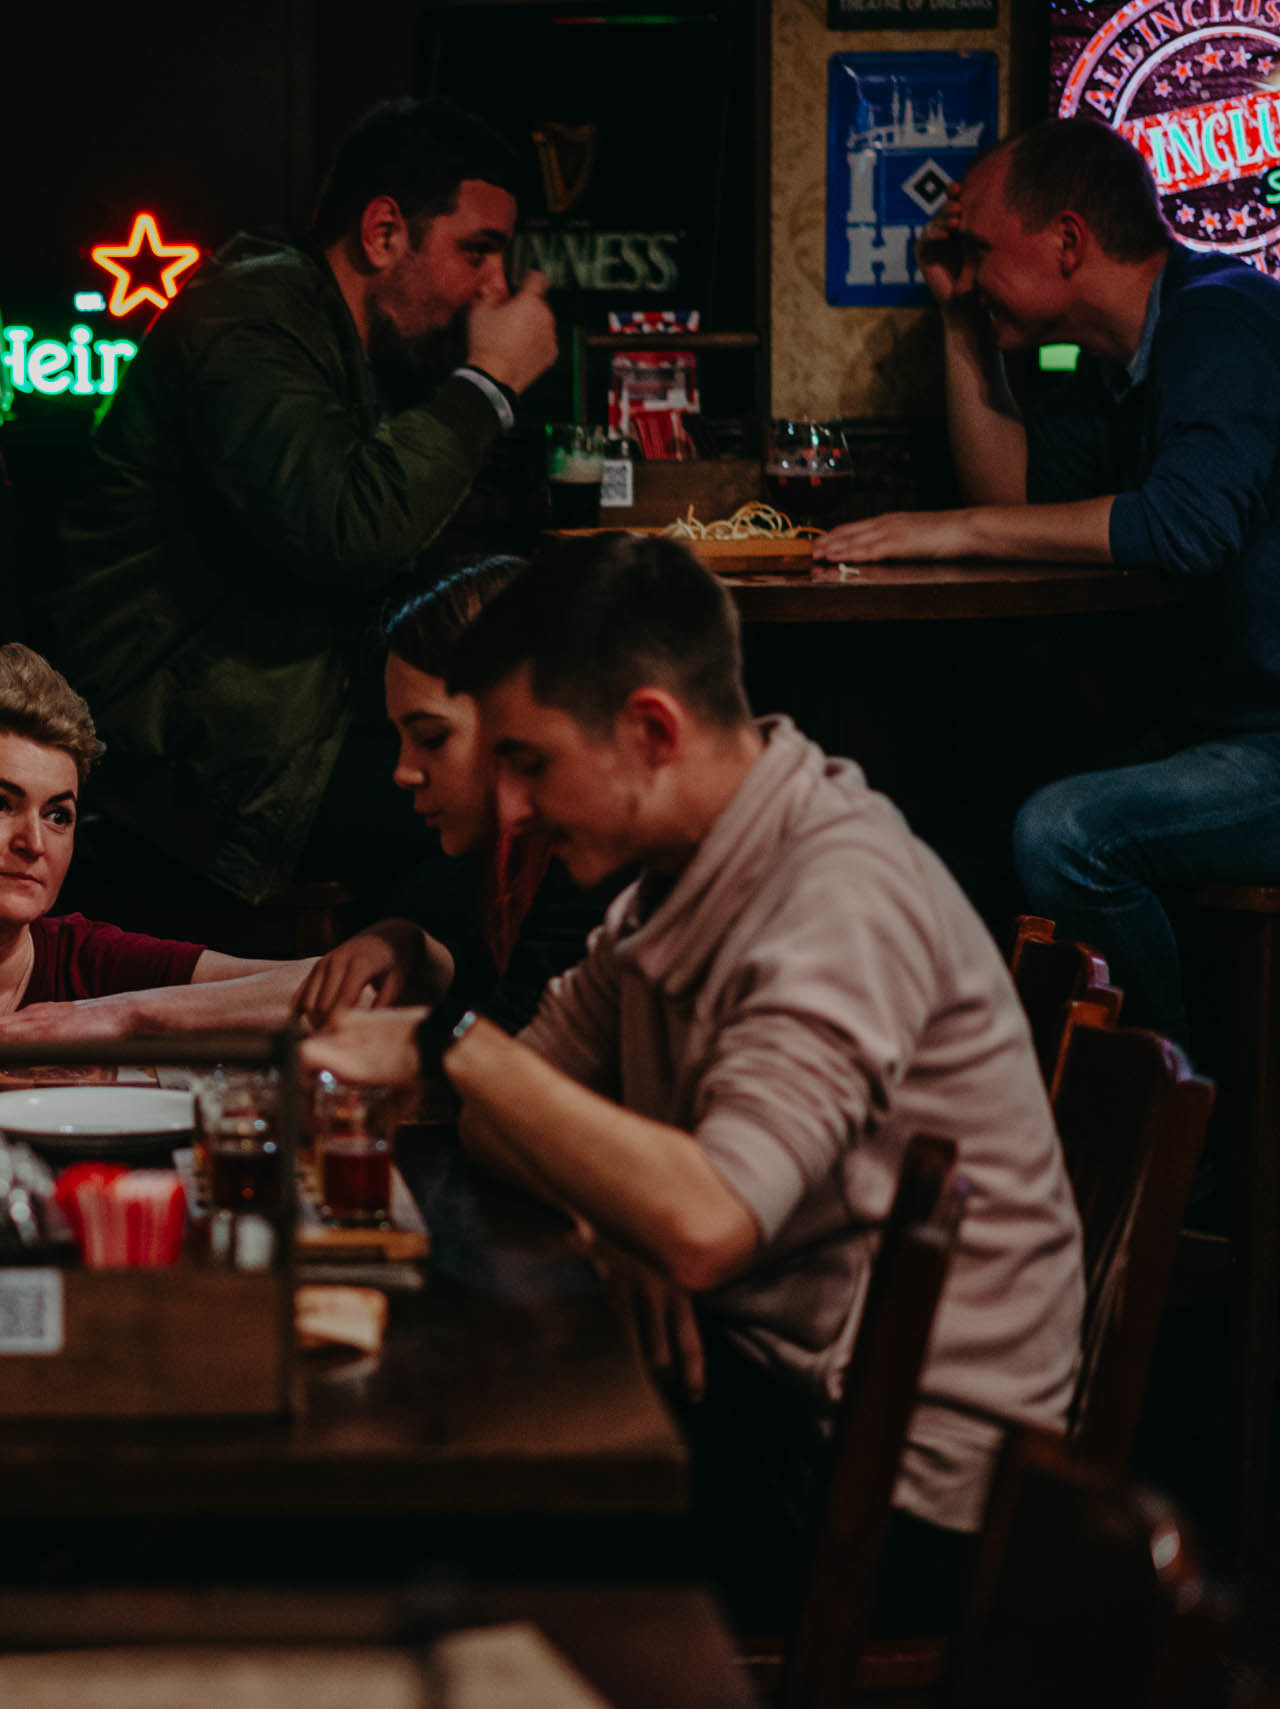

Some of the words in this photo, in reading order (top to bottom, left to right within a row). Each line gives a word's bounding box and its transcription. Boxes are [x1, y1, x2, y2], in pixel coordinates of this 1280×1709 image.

[1083, 41, 1145, 119] ALL
[845, 150, 878, 224] I
[844, 225, 927, 286] H
